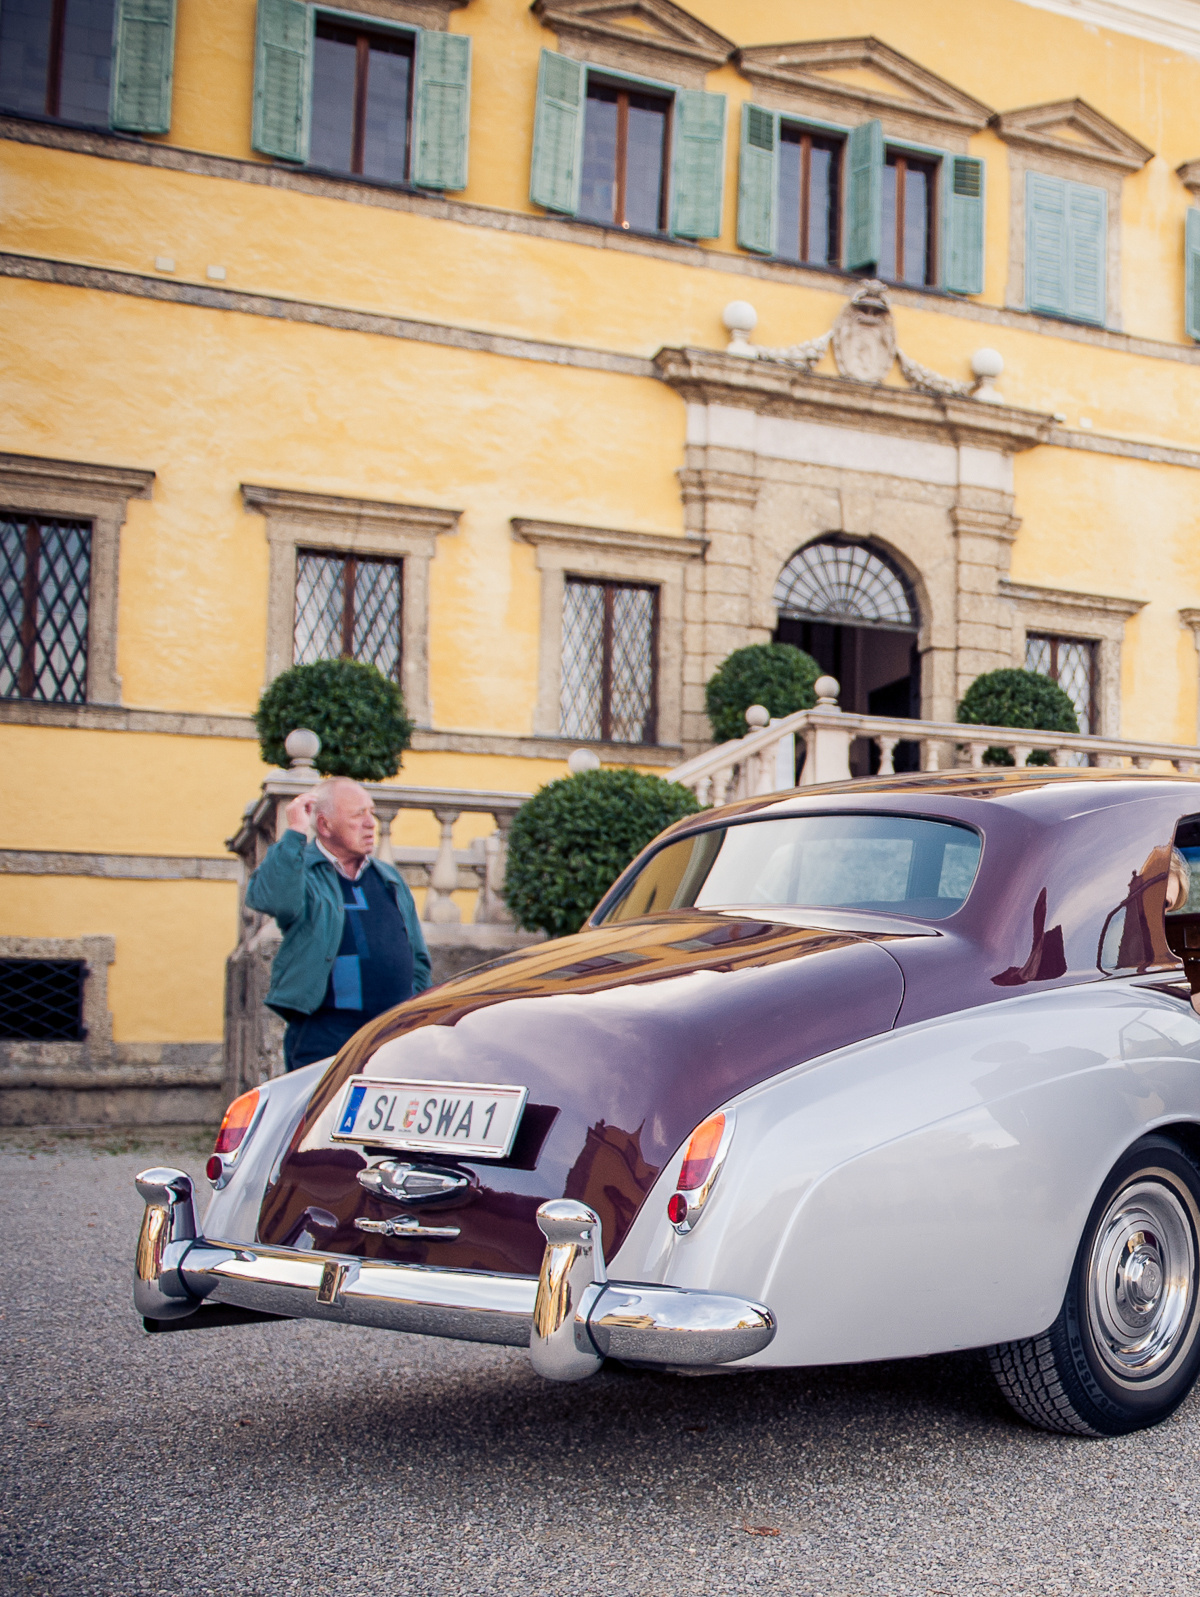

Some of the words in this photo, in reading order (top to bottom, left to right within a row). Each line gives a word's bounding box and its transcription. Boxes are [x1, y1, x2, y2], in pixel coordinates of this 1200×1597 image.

[344, 1116, 352, 1128] A
[368, 1095, 397, 1131] SL
[417, 1098, 474, 1138] SWA
[482, 1102, 497, 1139] 1
